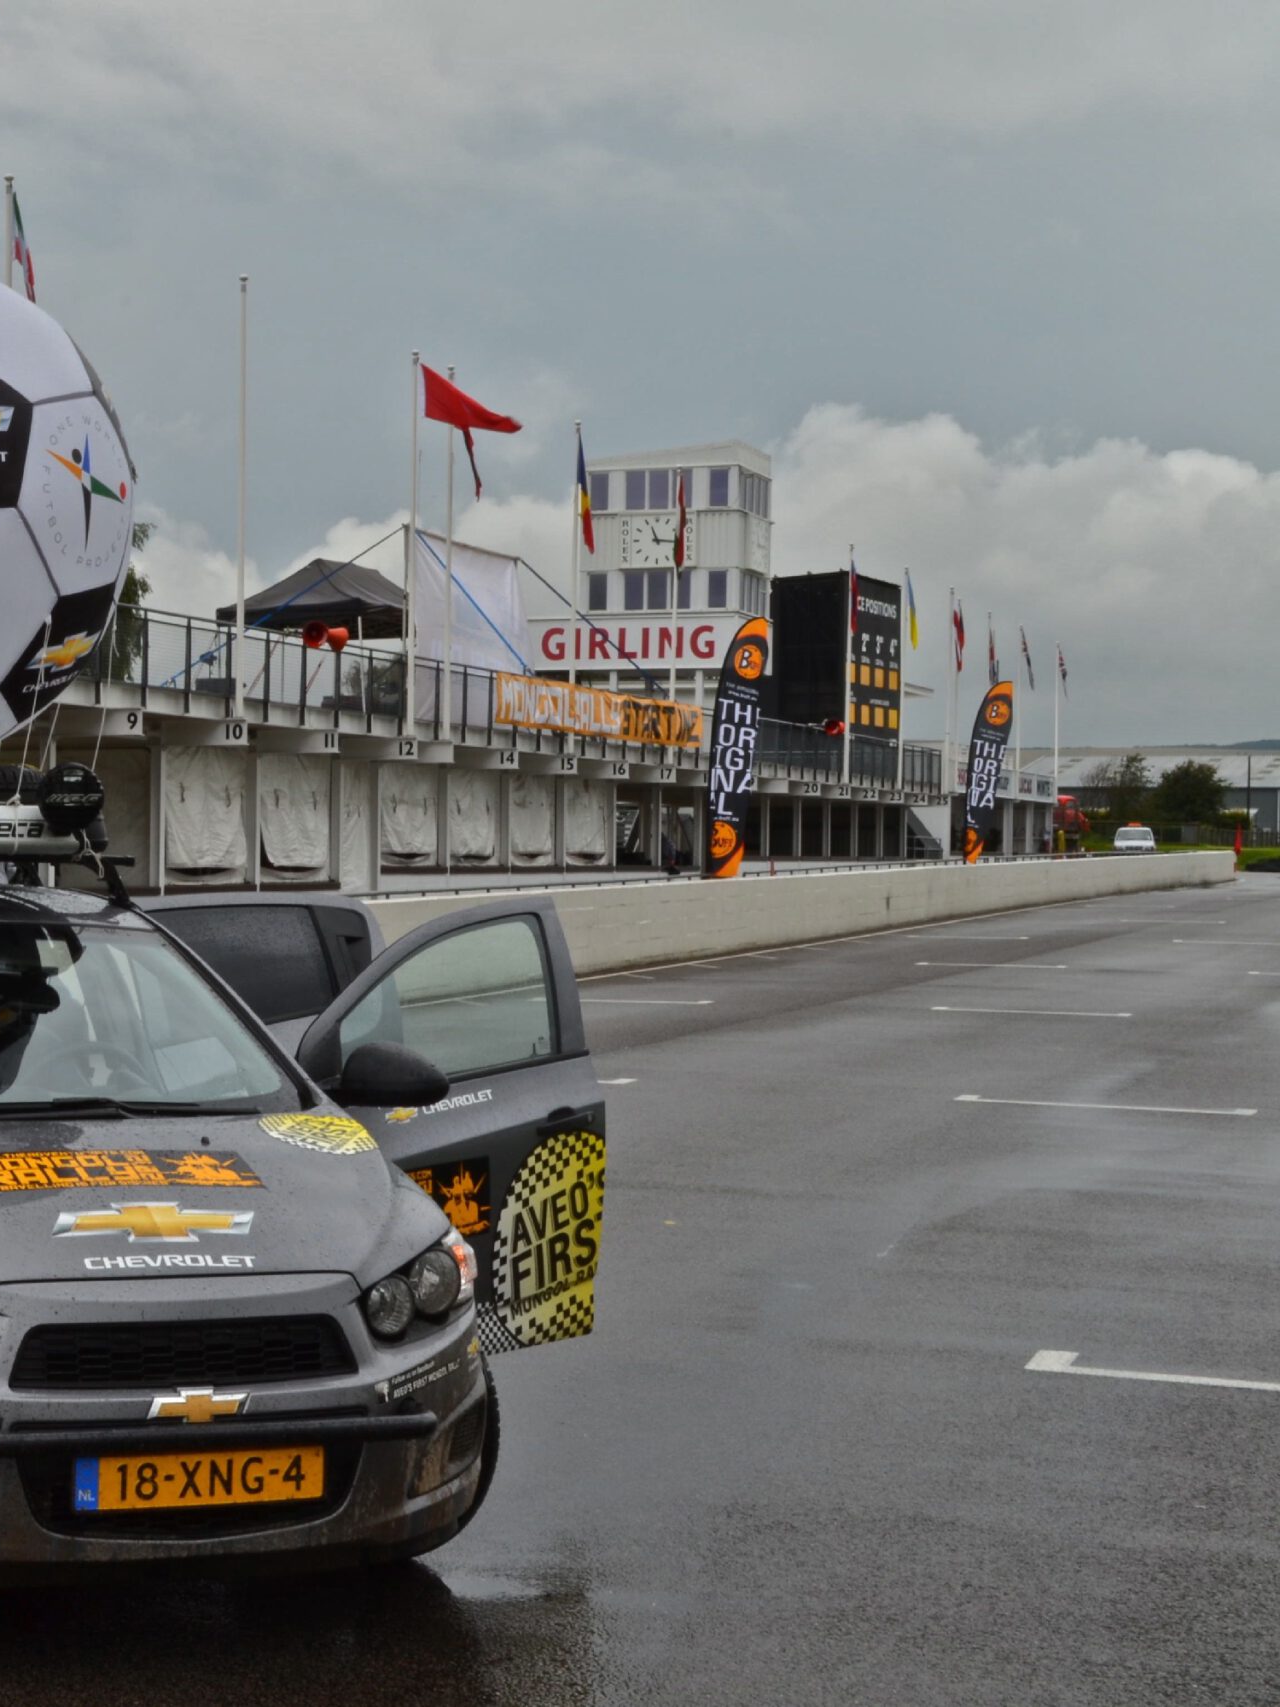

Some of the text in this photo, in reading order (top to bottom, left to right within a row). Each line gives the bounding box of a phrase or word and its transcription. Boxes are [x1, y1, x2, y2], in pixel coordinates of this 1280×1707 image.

[621, 519, 630, 564] ROLEX
[865, 598, 897, 619] POSITIONS
[541, 625, 716, 662] GIRLING
[127, 712, 138, 730] 9
[225, 724, 243, 740] 10
[718, 724, 757, 749] OR
[324, 733, 335, 749] 11
[398, 741, 414, 756] 12
[500, 751, 515, 765] 14
[561, 757, 574, 771] 15
[612, 763, 626, 776] 16
[659, 767, 671, 781] 17
[973, 757, 998, 776] OR
[804, 783, 819, 793] 20
[839, 786, 849, 796] 21
[863, 789, 876, 798] 22
[423, 1089, 493, 1115] CHEVROLET
[84, 1256, 256, 1270] CHEVROLET
[510, 1212, 603, 1301] FIRS
[393, 1383, 413, 1400] AVEO'S
[413, 1375, 428, 1390] FIRST
[78, 1454, 306, 1501] NL 18-XNG-4
